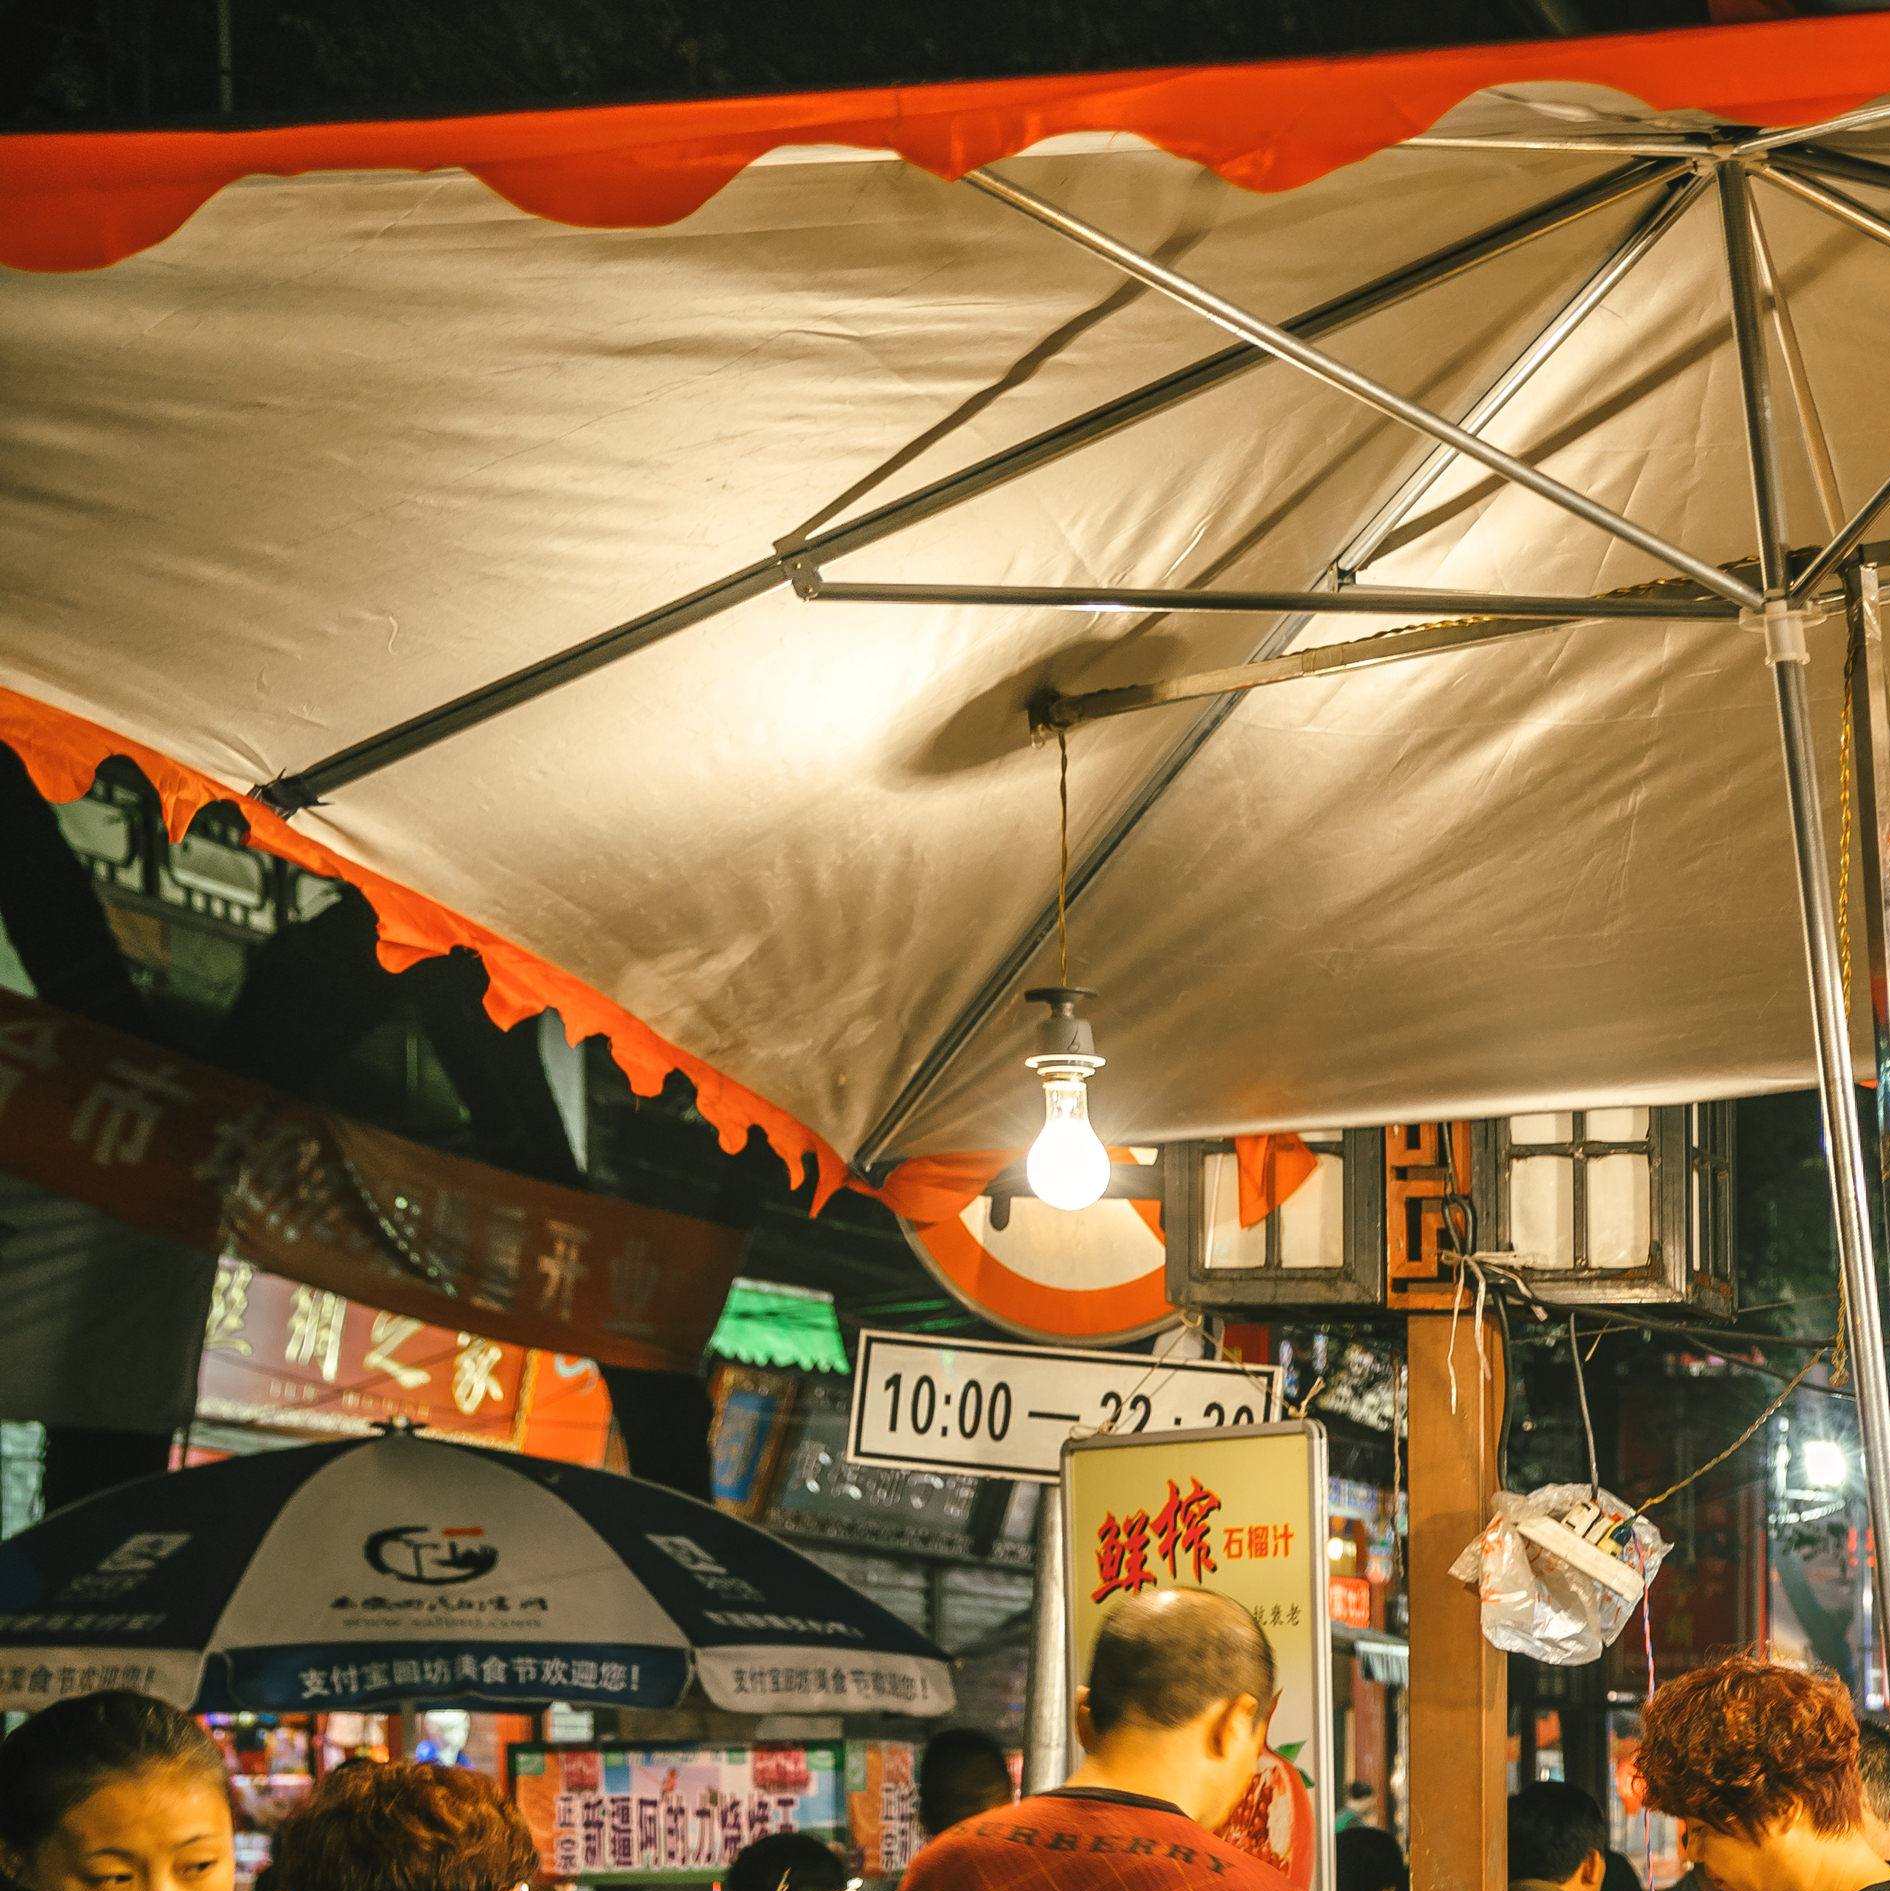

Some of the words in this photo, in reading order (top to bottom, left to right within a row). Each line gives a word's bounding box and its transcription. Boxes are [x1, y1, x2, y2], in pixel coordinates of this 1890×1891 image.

[884, 1374, 1012, 1442] 10:00
[1090, 1475, 1222, 1604] 鲜榨
[1222, 1522, 1294, 1561] 石榴汁
